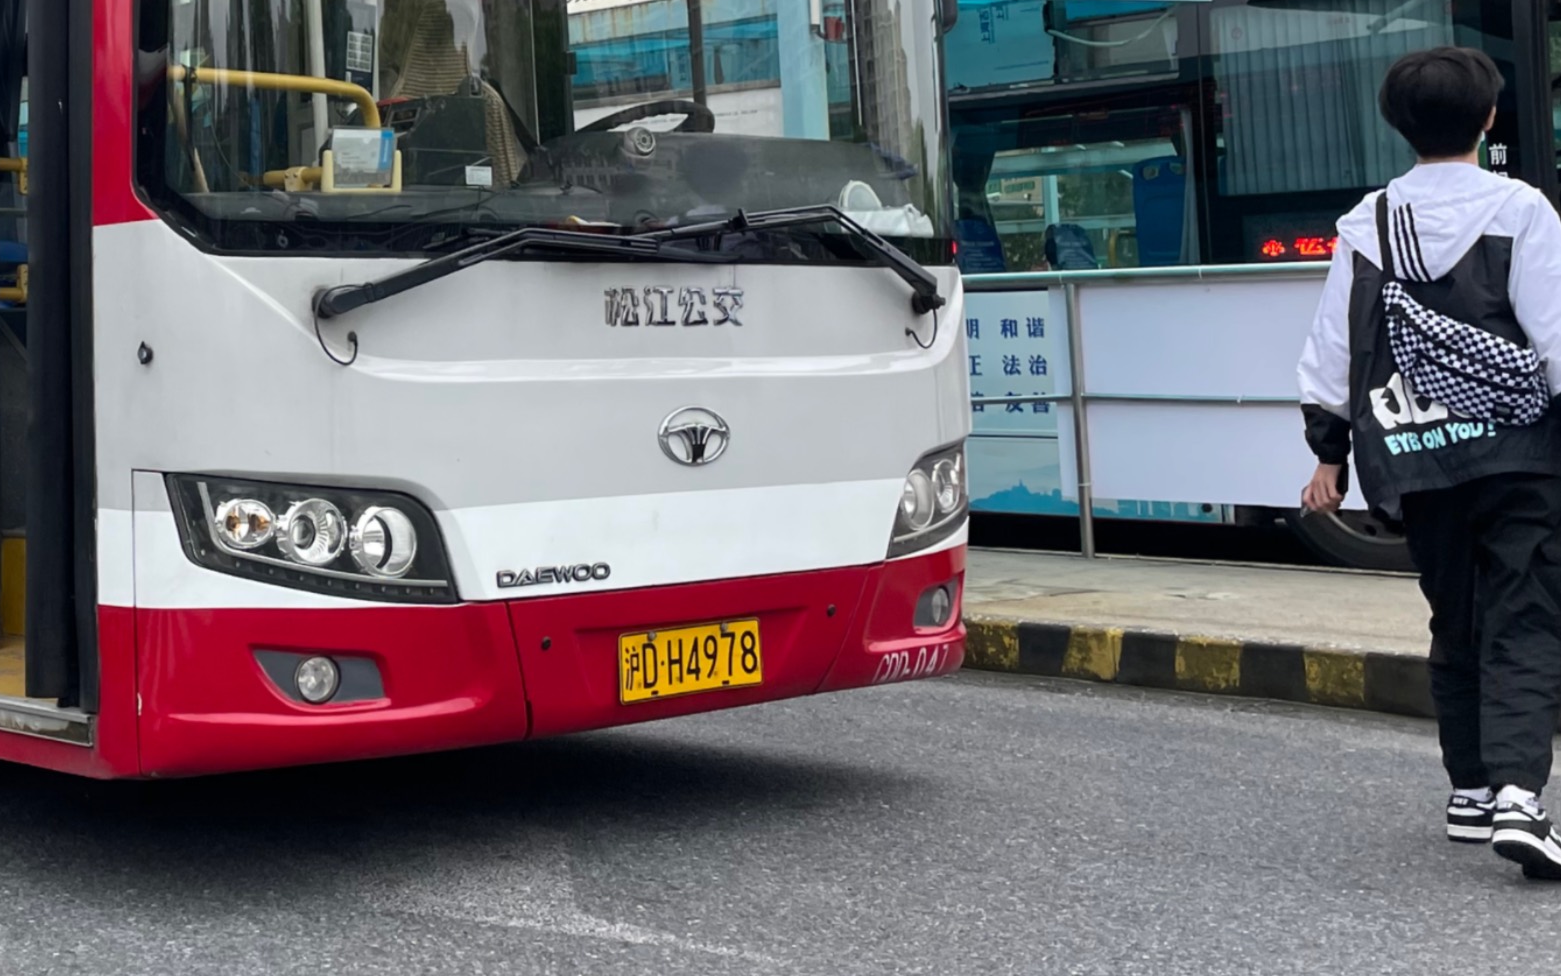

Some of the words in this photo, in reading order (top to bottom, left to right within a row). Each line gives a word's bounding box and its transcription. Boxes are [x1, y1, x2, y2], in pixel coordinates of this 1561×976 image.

[603, 284, 744, 327] 松江公交
[1000, 317, 1045, 339] 和谐
[1002, 354, 1048, 376] 法治
[1422, 427, 1447, 449] ON
[496, 562, 611, 588] DAEWOO
